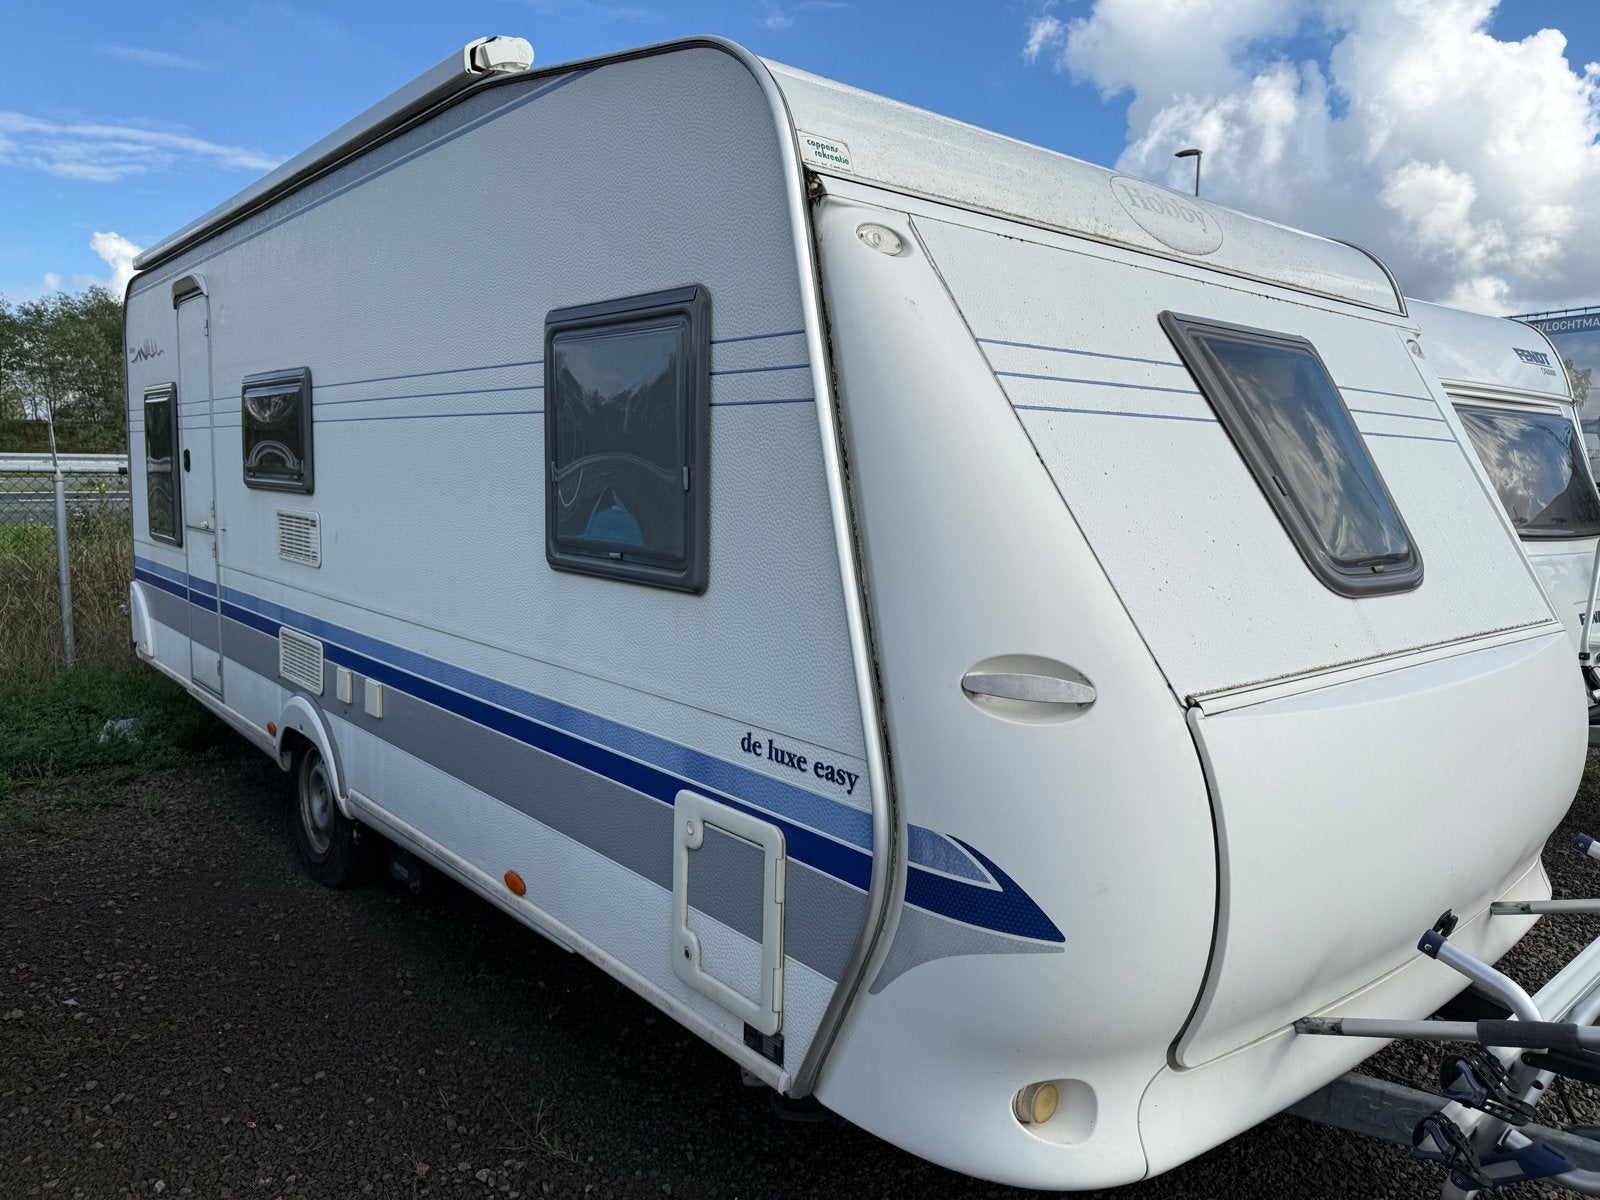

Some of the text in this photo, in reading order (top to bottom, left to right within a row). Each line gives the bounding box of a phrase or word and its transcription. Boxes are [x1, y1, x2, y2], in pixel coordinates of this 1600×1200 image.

[1119, 183, 1207, 234] Hobby
[1512, 347, 1550, 366] FENDT
[740, 732, 859, 795] de luxe easy
